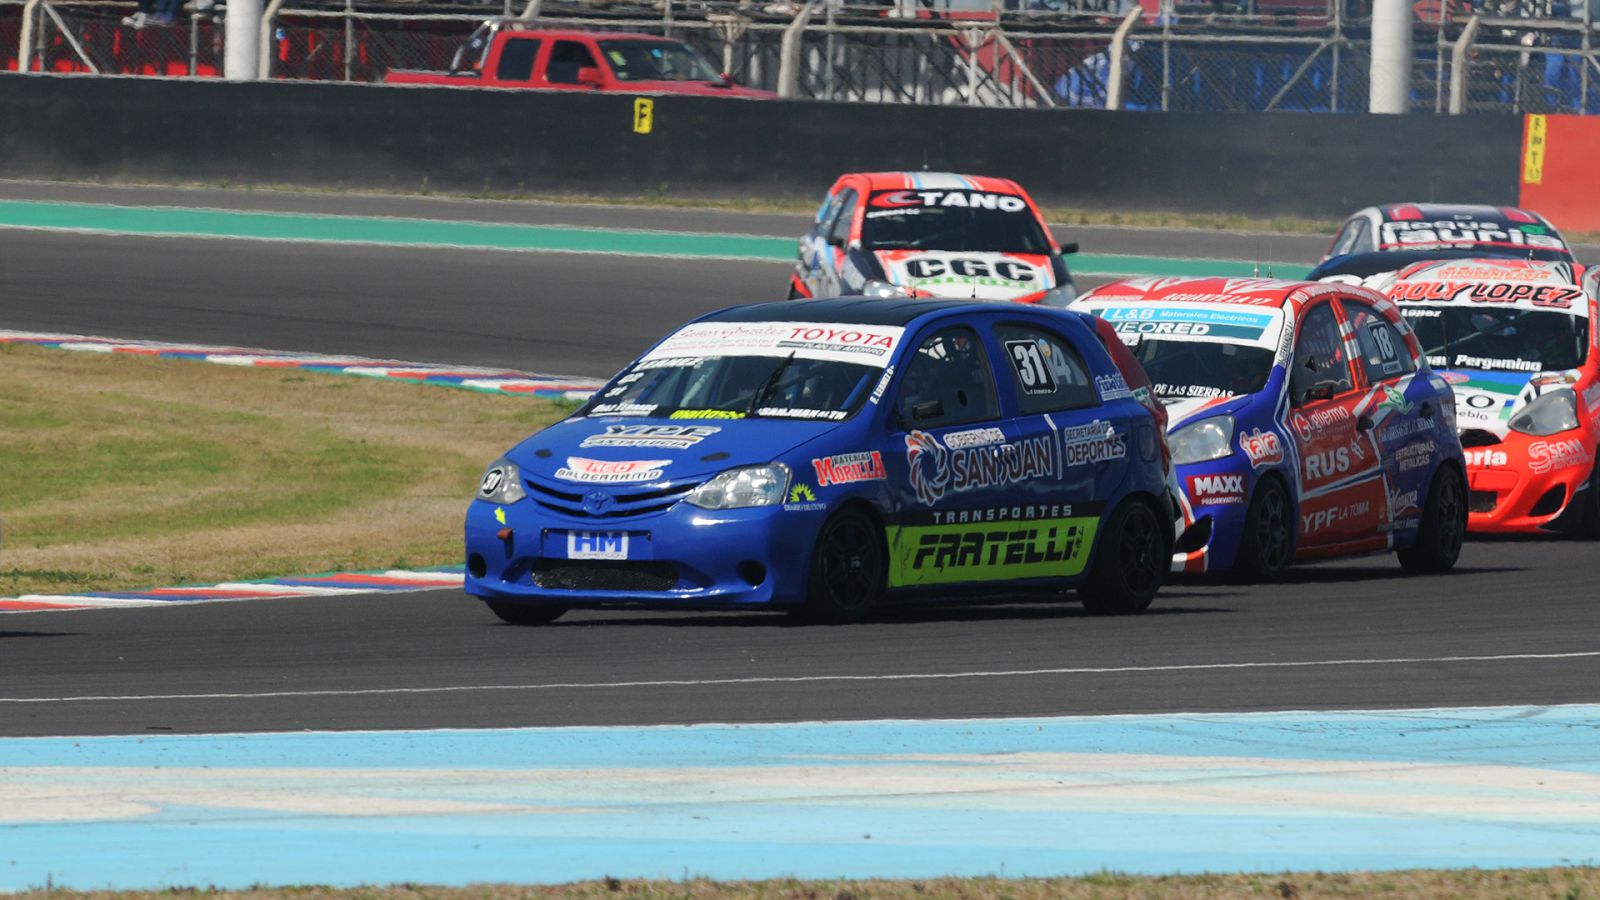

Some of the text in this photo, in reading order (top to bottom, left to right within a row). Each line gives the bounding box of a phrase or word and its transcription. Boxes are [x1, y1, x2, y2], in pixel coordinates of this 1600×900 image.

[918, 191, 1027, 213] TANO
[905, 258, 1035, 282] CGC
[1387, 282, 1584, 308] ROLY LOPEZ
[788, 327, 894, 349] TOYOTA
[1372, 326, 1395, 361] 18
[1013, 344, 1047, 387] 31
[1454, 354, 1542, 372] Pergamino
[1153, 383, 1235, 399] DE LAS SIERRAS
[606, 425, 721, 436] YPF
[1065, 435, 1127, 467] DEPORTES
[1305, 446, 1350, 480] RUS
[812, 451, 887, 487] MORILLA
[1194, 475, 1245, 496] MAXX
[933, 504, 1073, 524] TRANSPORTES
[1302, 506, 1338, 534] YPF
[574, 532, 622, 553] HM
[912, 526, 1077, 570] FRATELLI
